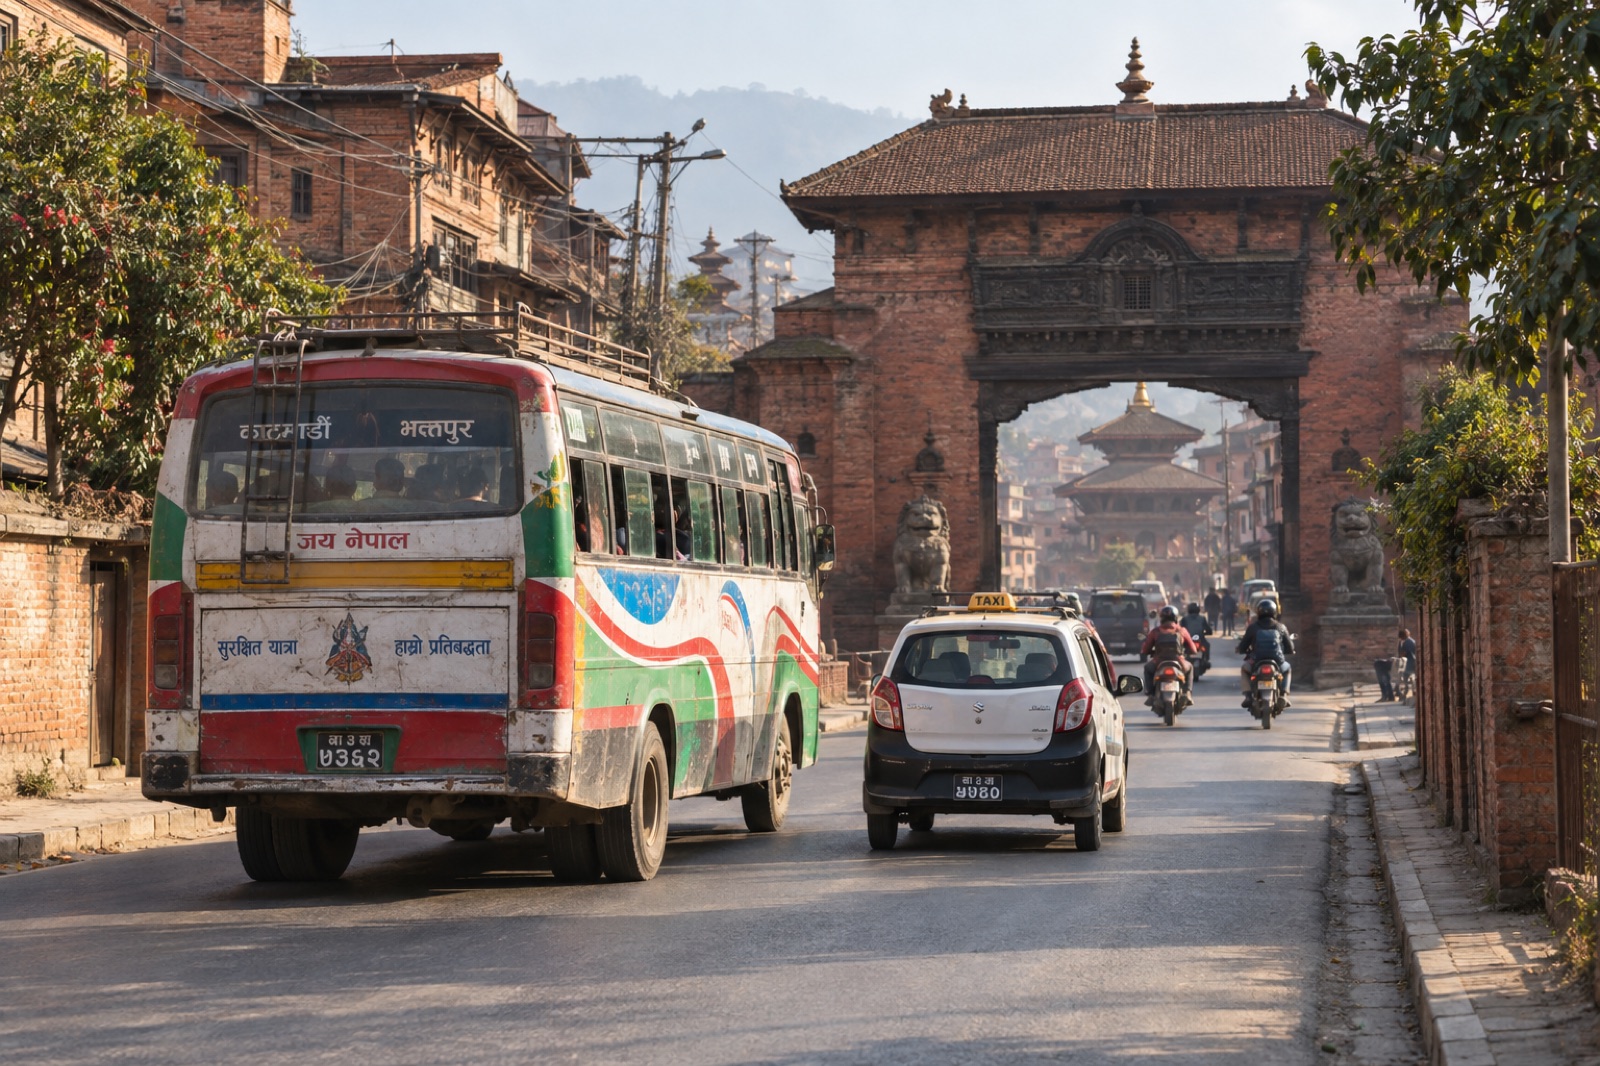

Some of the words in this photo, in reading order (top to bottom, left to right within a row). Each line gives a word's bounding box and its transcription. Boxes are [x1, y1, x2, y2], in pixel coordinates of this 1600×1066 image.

[296, 533, 337, 550] जय
[345, 527, 411, 550] नेपाल
[974, 595, 1005, 606] TAXI
[217, 635, 263, 661] सुरक्षित
[268, 639, 298, 655] यात्रा
[394, 634, 423, 657] हाम्रो
[428, 634, 492, 656] प्रतिबद्धता
